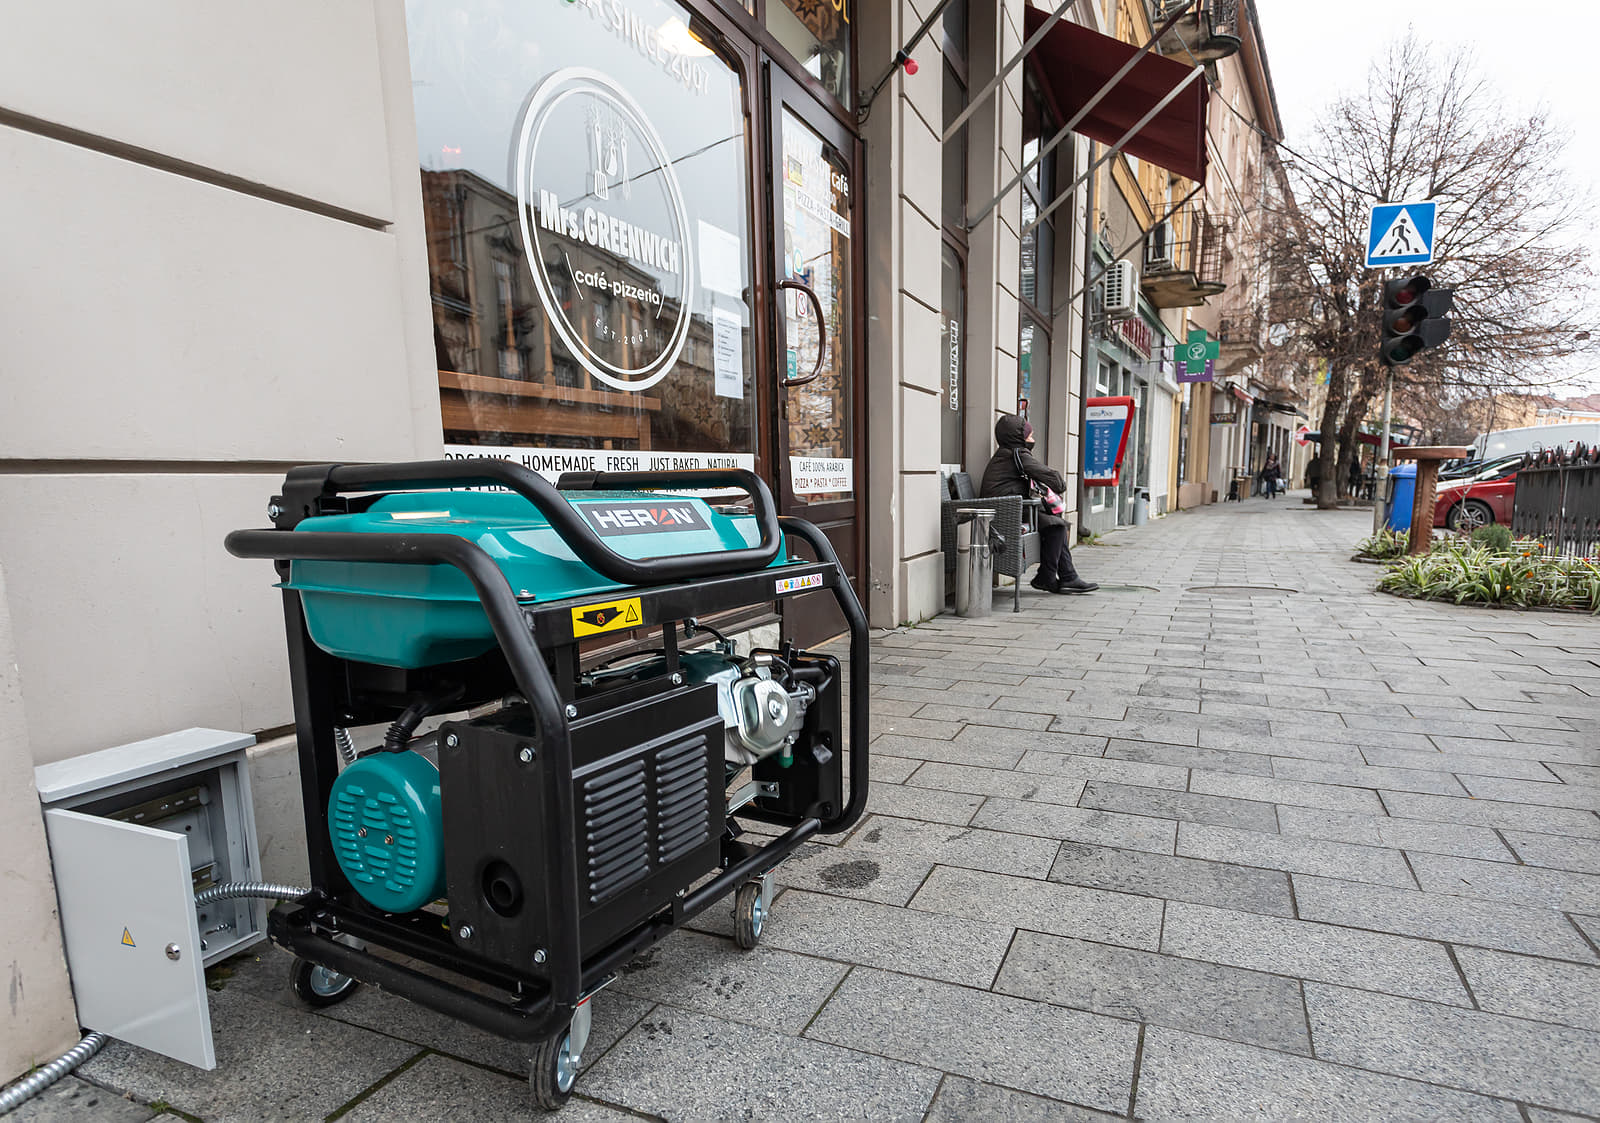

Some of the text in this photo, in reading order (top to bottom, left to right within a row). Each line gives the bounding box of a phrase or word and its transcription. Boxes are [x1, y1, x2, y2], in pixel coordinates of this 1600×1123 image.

[831, 172, 849, 197] café
[574, 271, 661, 305] café-pizzeria
[521, 454, 597, 472] HOMEMADE
[607, 456, 639, 472] FRESH
[648, 457, 670, 472] JUST
[673, 458, 700, 471] BAKED
[812, 462, 826, 472] 100%
[795, 477, 848, 489] PIZZA PASTA COFFEE
